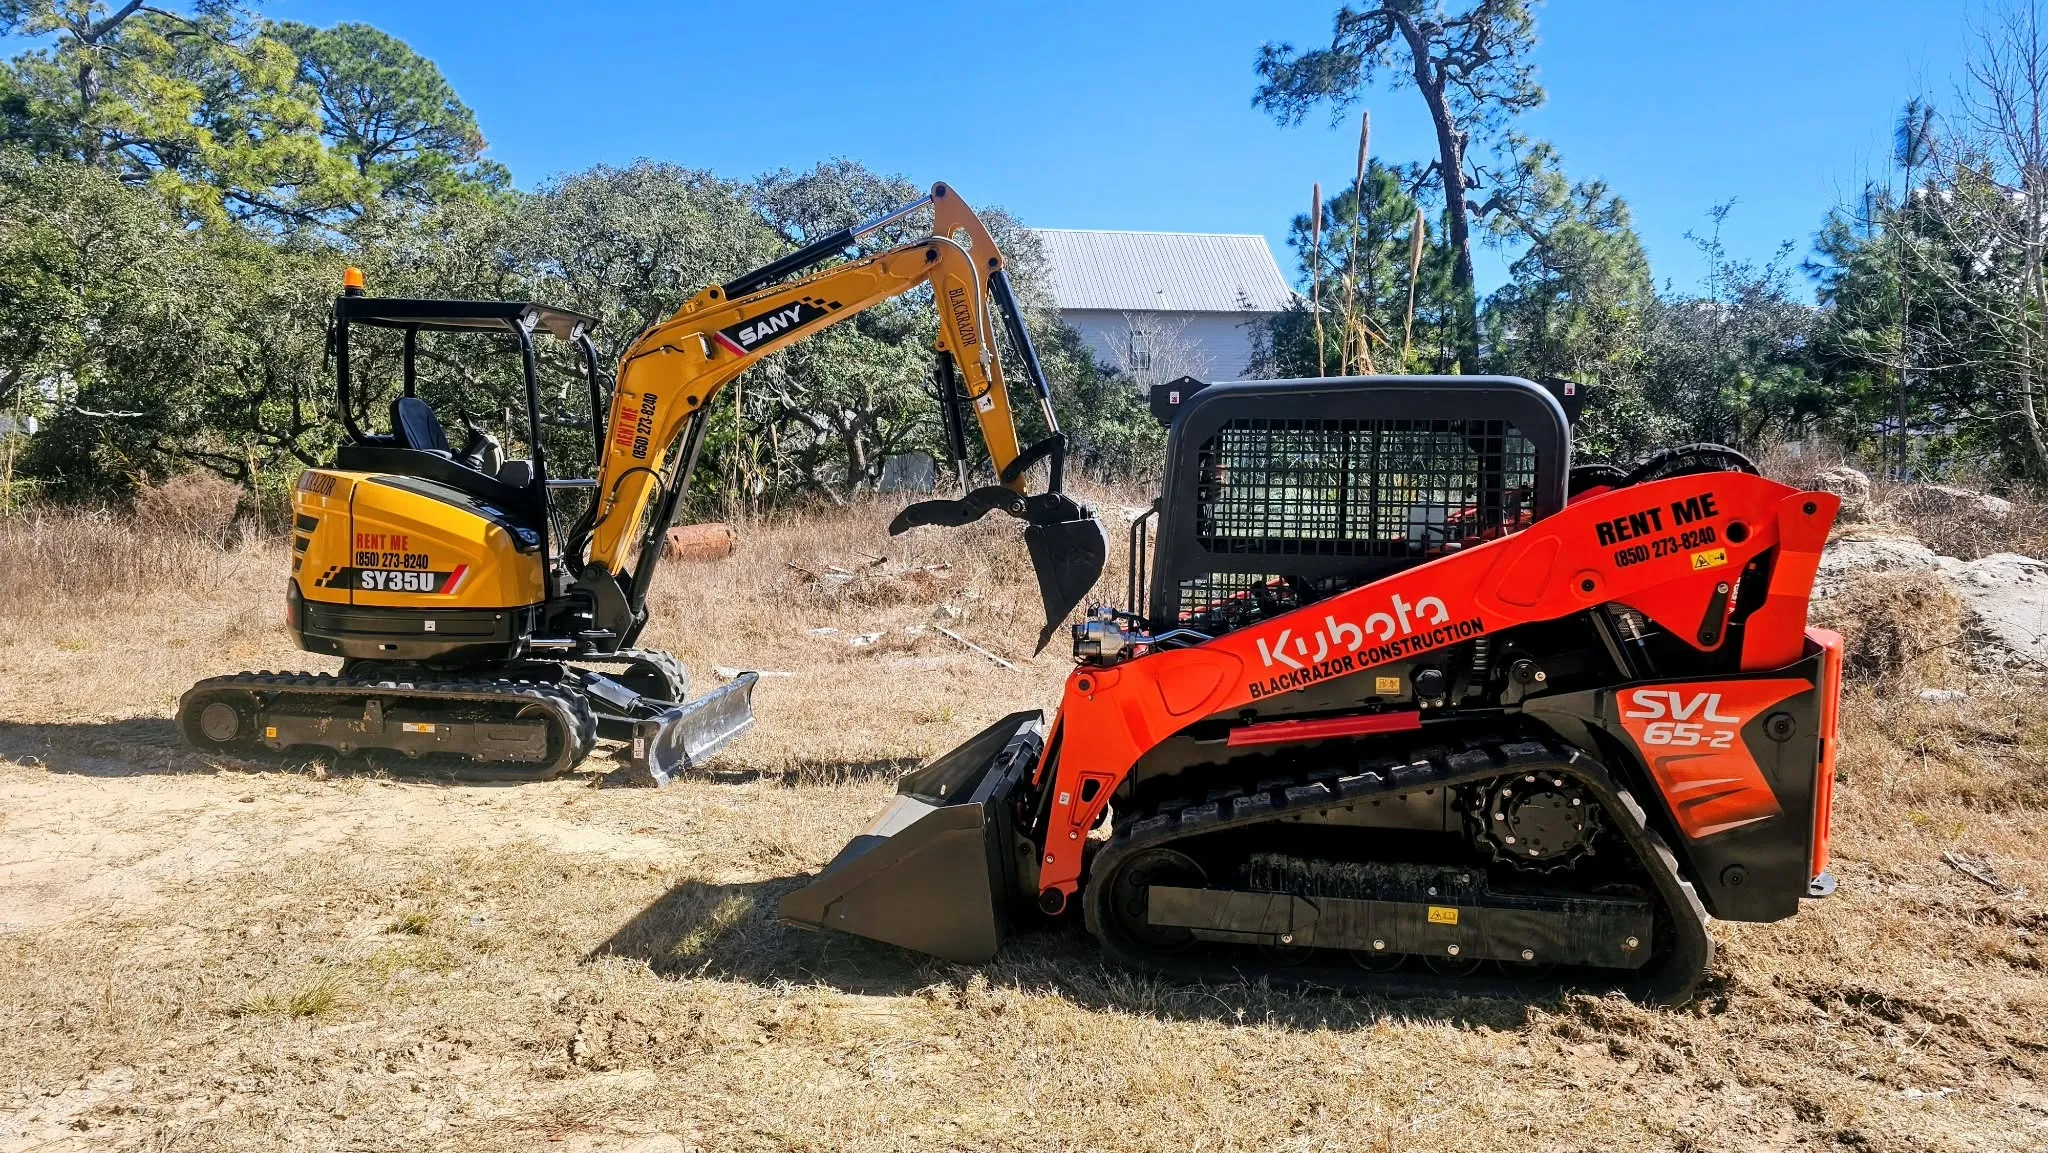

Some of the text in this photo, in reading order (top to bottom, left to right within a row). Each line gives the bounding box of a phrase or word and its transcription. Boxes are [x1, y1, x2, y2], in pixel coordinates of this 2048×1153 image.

[738, 304, 801, 347] SANY
[949, 287, 977, 348] BLACKRAZOR
[616, 422, 635, 447] RENT
[632, 393, 658, 460] (850) 273-8240
[1595, 492, 1720, 547] RENT ME
[355, 551, 429, 570] (850) 273-8240
[356, 533, 408, 552] RENT ME
[1614, 525, 1716, 569] (850) 273-8240
[361, 570, 435, 592] SY35U
[1255, 593, 1451, 670] Kubota
[1248, 616, 1485, 700] BLACKRAZOR CONSTRUCTION
[1625, 689, 1741, 724] SVL
[1643, 721, 1735, 749] 65-2
